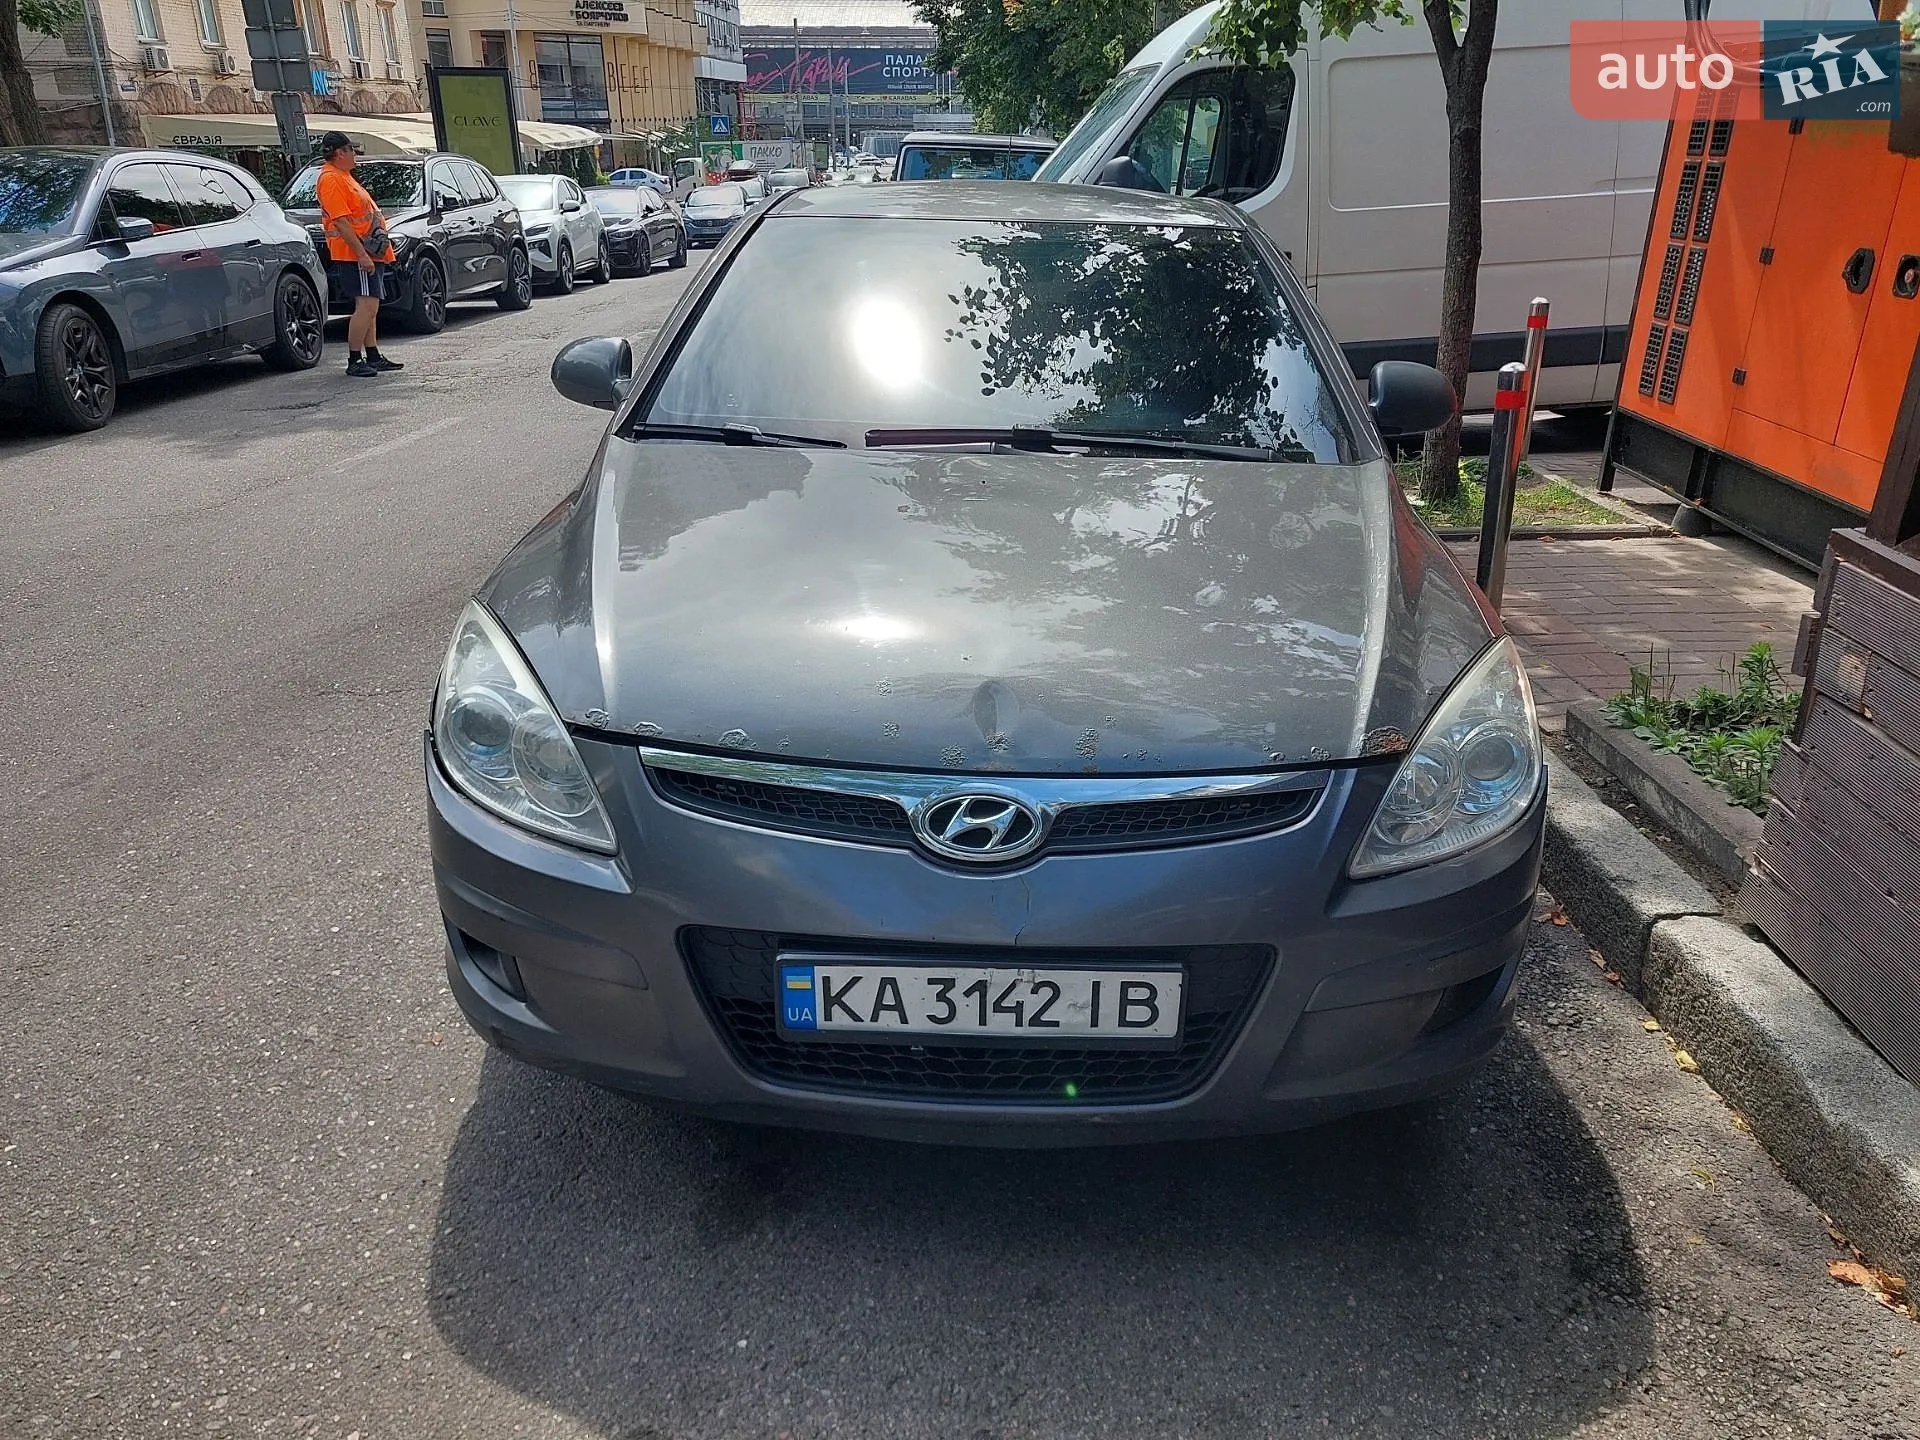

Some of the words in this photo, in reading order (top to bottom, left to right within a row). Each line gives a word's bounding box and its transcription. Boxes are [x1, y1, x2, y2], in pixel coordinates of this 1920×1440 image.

[885, 54, 929, 66] ПАЛА
[606, 61, 649, 94] BEEF
[821, 975, 910, 1024] KA
[925, 977, 1062, 1028] 3142
[1089, 980, 1160, 1029] IB
[787, 1007, 814, 1021] UA
